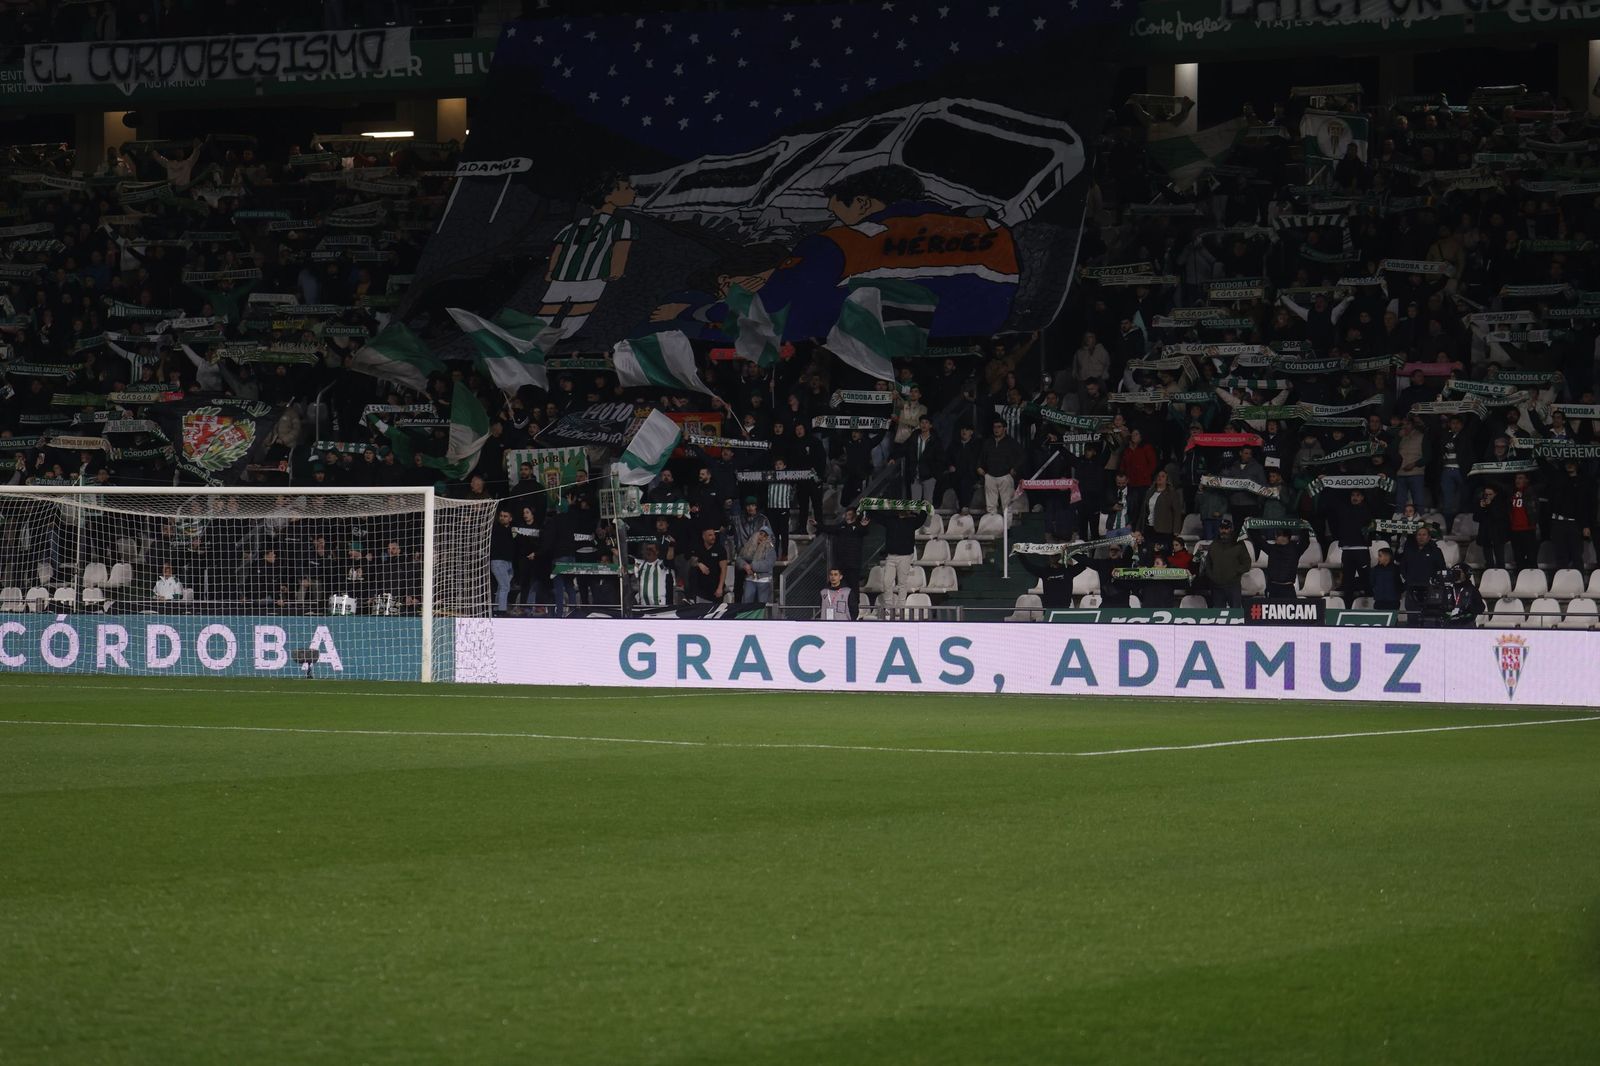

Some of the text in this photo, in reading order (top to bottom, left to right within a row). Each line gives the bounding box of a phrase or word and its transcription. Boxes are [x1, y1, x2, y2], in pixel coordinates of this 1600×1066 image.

[31, 45, 72, 84] EL
[459, 159, 521, 172] ADAMUZ
[883, 227, 999, 257] HÉROES
[1250, 604, 1317, 621] #FANCAM
[0, 614, 343, 671] CÓRDOBA
[619, 632, 1422, 694] GRACIAS, ADAMUZ
